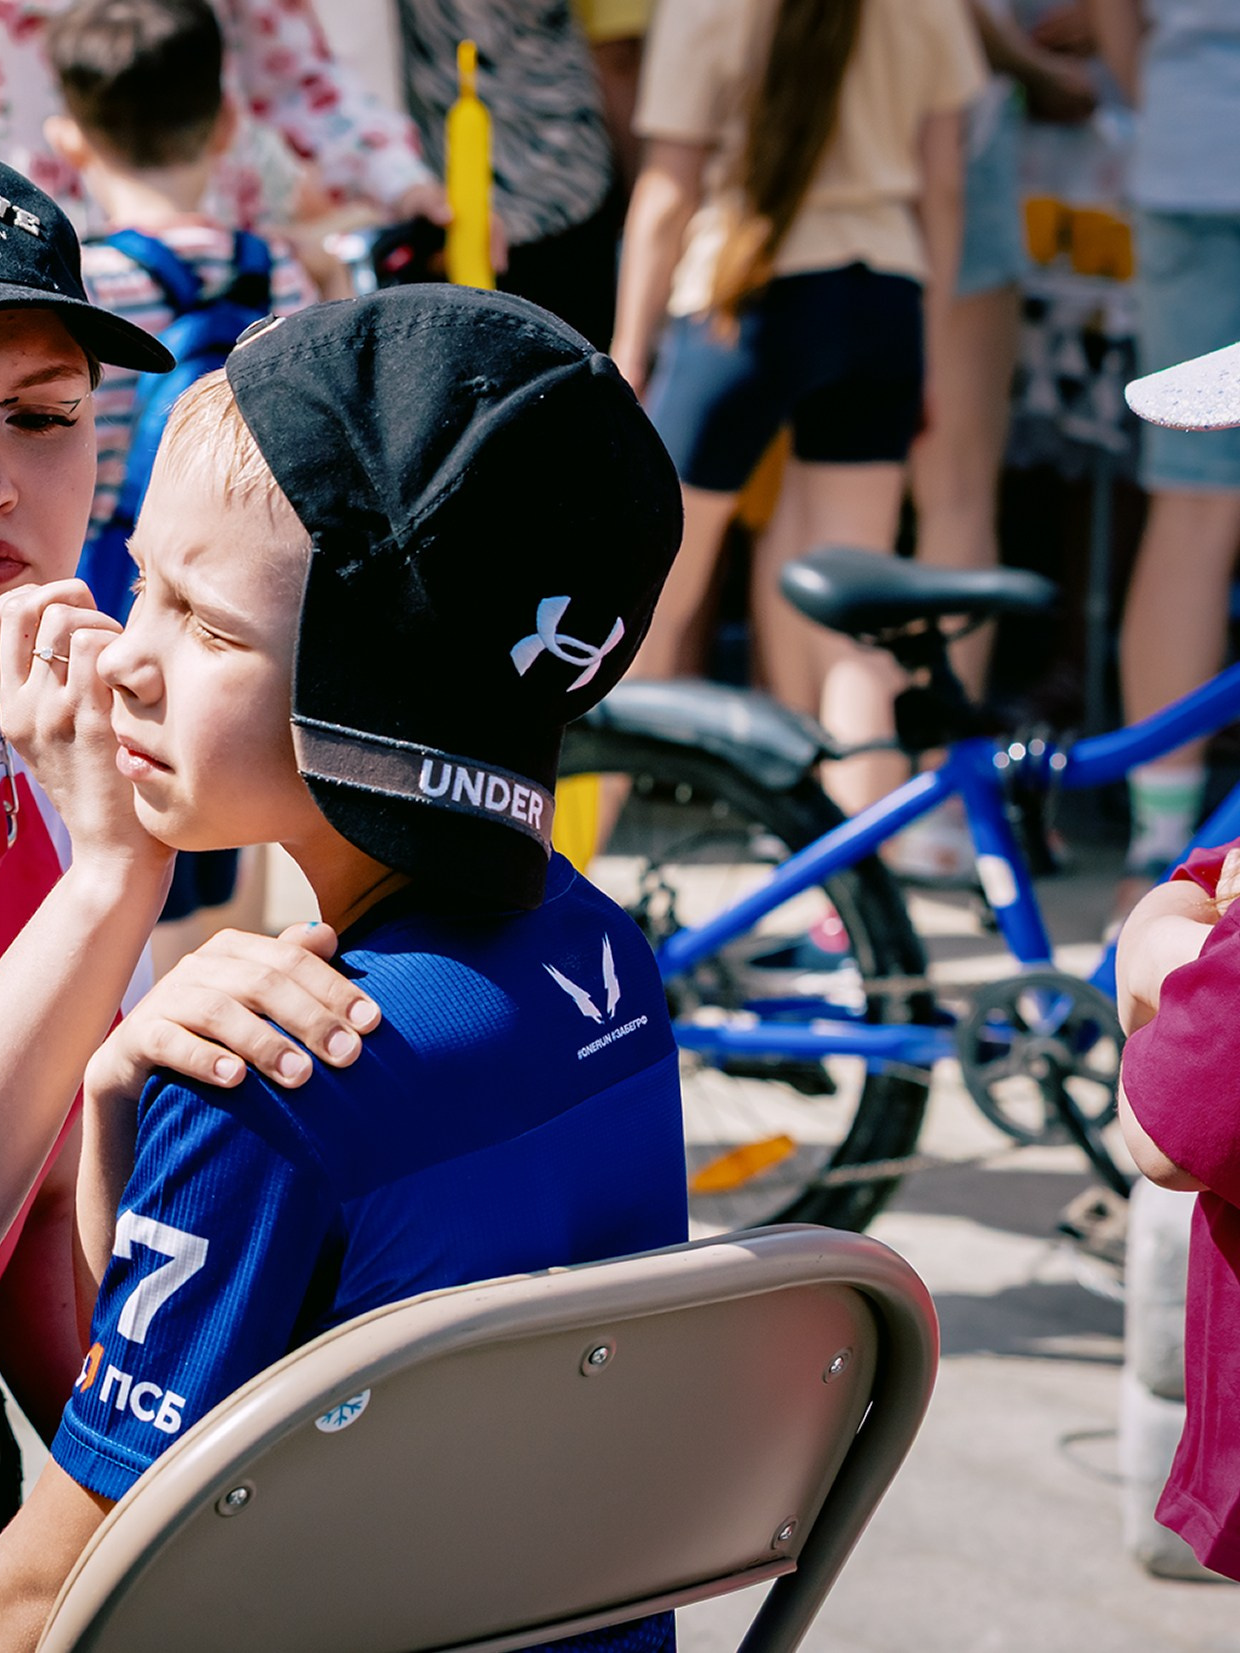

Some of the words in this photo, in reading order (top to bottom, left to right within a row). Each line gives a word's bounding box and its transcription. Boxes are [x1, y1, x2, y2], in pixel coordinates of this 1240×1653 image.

[418, 758, 544, 830] UNDER
[112, 1208, 209, 1344] 7
[98, 1363, 187, 1434] ПСБ
